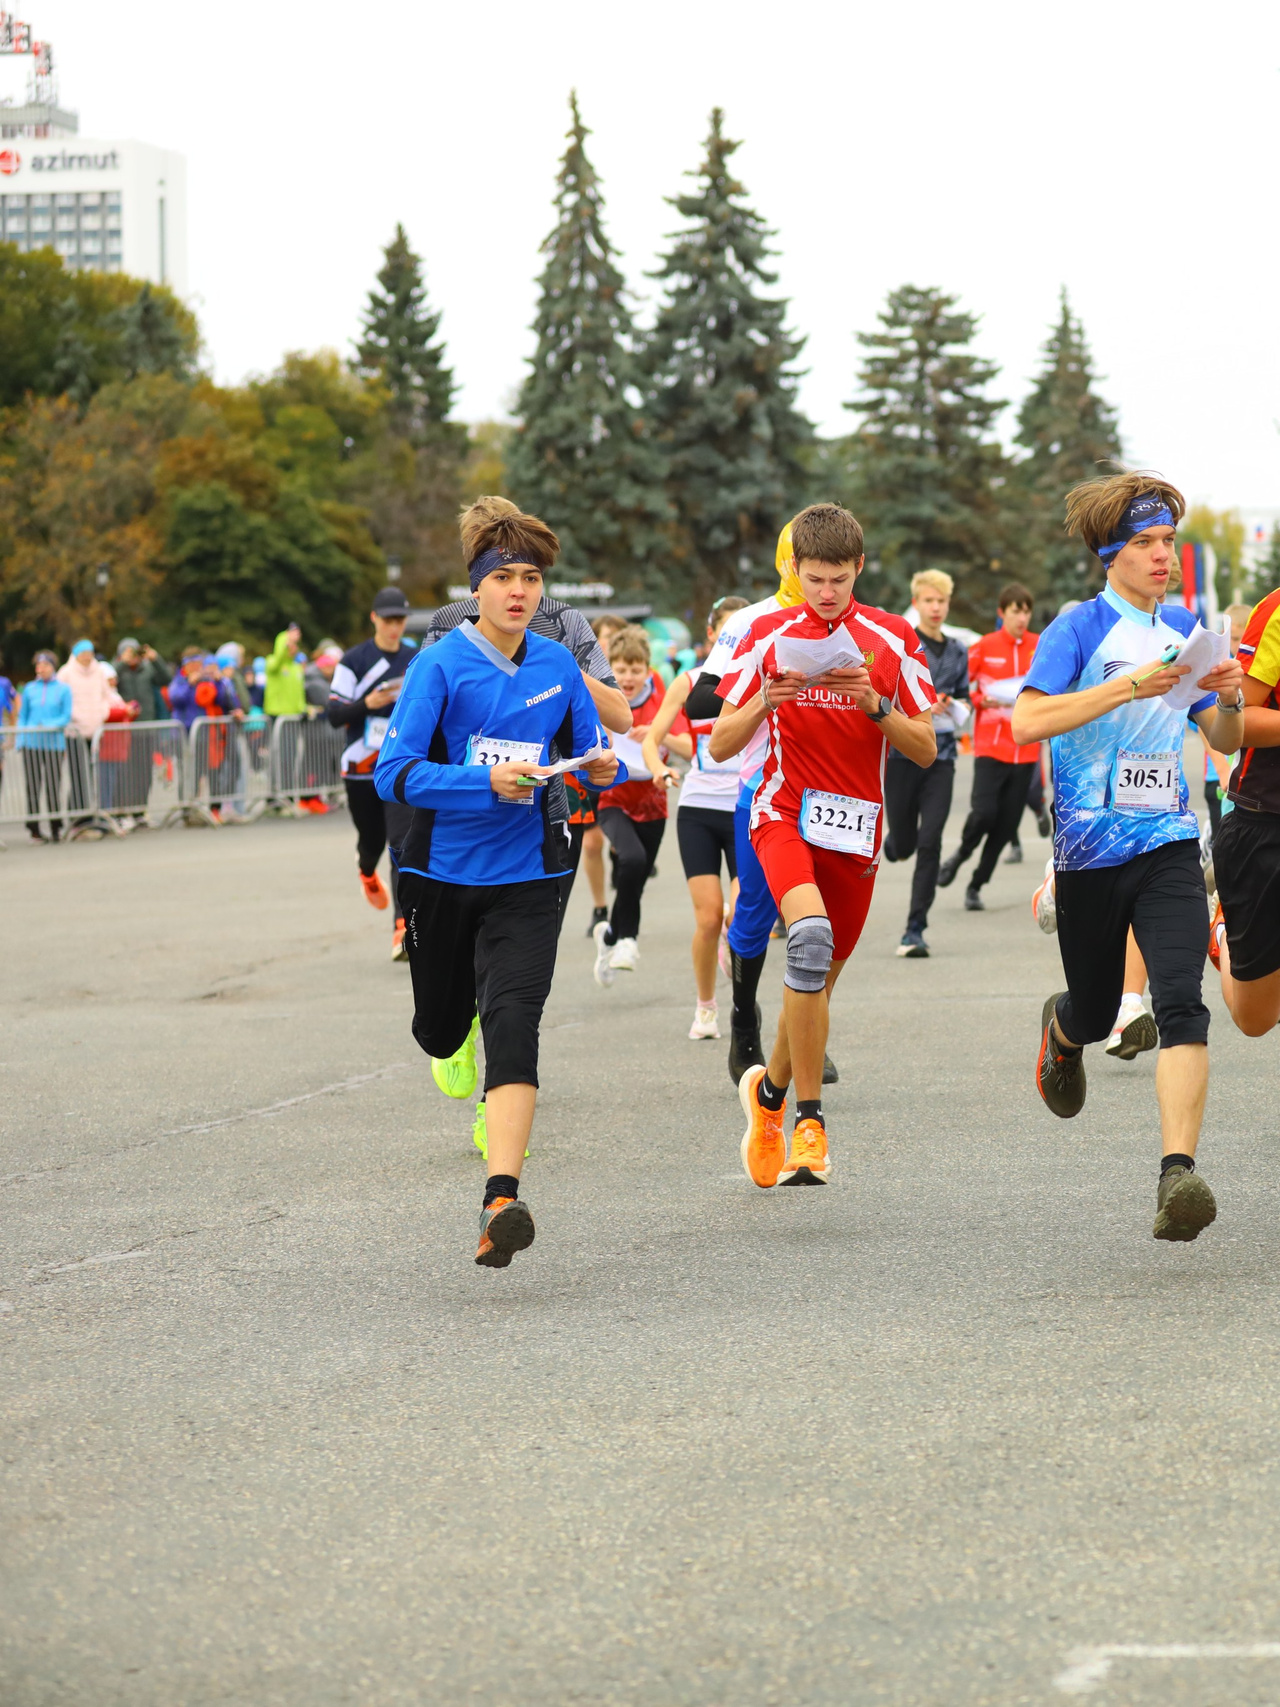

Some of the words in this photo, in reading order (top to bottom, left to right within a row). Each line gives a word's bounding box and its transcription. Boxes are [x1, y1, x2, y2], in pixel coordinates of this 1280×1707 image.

[31, 149, 119, 171] azimut
[525, 684, 562, 708] noname
[1118, 768, 1172, 789] 305.1
[809, 805, 864, 832] 322.1
